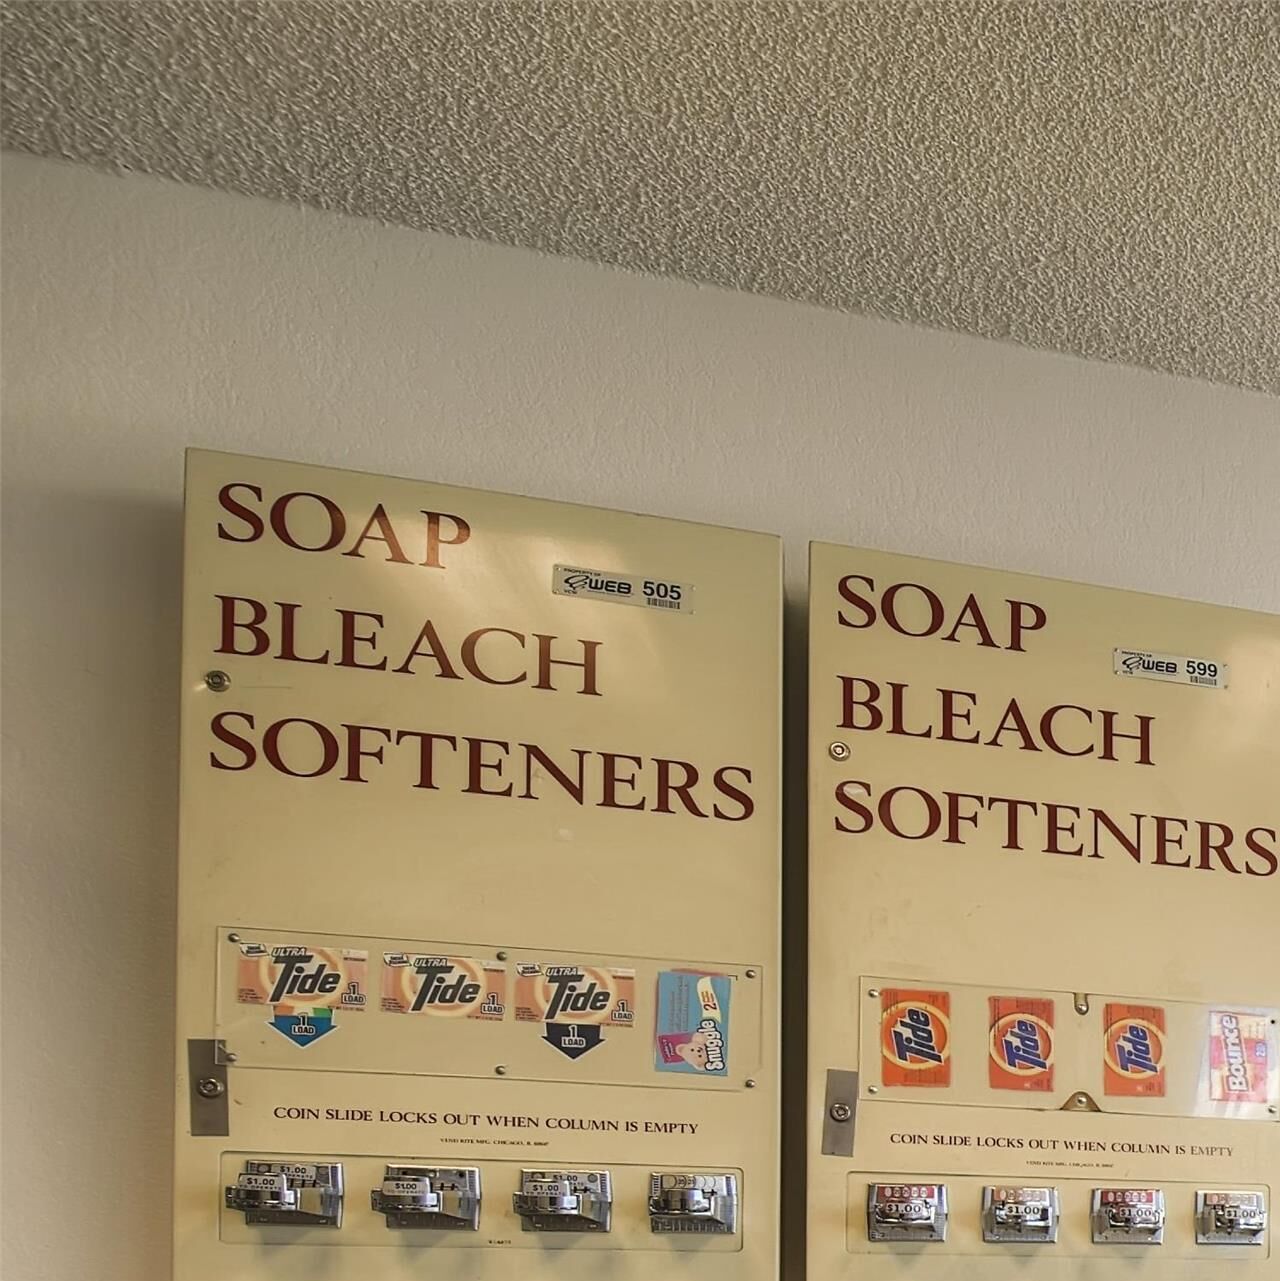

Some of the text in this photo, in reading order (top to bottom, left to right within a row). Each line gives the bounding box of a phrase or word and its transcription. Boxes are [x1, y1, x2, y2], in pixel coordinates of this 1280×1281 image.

[217, 482, 472, 569] SOAP
[588, 578, 632, 595] WEB
[642, 580, 682, 600] 505
[837, 574, 1047, 652] SOAP
[213, 594, 603, 697] BLEACH
[1142, 659, 1178, 673] WEB
[1186, 660, 1218, 677] 599
[836, 674, 1156, 766] BLEACH
[209, 711, 755, 822] SOFTENERS
[834, 780, 1279, 877] SOFTENERS
[271, 947, 308, 957] ULTRA
[413, 957, 448, 967] ULTRA
[545, 967, 578, 976] ULTRA
[269, 955, 342, 1003] Tide
[348, 983, 359, 995] 1
[410, 966, 481, 1011] Tide
[342, 994, 366, 1004] LOAD
[488, 993, 498, 1005] 1
[544, 975, 611, 1020] Tide
[481, 1004, 504, 1014] LOAD
[618, 1001, 628, 1012] 1
[299, 1014, 309, 1026] 1
[612, 1012, 634, 1020] LOAD
[292, 1026, 315, 1034] LOAD
[568, 1025, 578, 1038] 1
[892, 1007, 944, 1065] Tide
[562, 1037, 586, 1047] LOAD
[698, 1019, 725, 1071] Snuggle
[1003, 1019, 1048, 1071] Tide
[1116, 1024, 1159, 1073] Tide
[1222, 1015, 1249, 1092] Bounce
[273, 1106, 699, 1135] COIN SLIDE LOCKS OUT WHEN COLUMN IS EMPTY
[890, 1132, 1235, 1158] COIN SLIDE LOCKS OUT WHEN COLUMN IS EMPTY
[280, 1165, 307, 1174] $1.00
[247, 1177, 275, 1186] $1.00
[553, 1174, 578, 1182] $1.00
[395, 1182, 417, 1190] $1.00
[532, 1184, 559, 1192] $1.00
[887, 1203, 921, 1214] $1.00
[1007, 1205, 1040, 1215] $1.00
[1120, 1208, 1152, 1217] $1.00
[1226, 1209, 1257, 1219] $1.00
